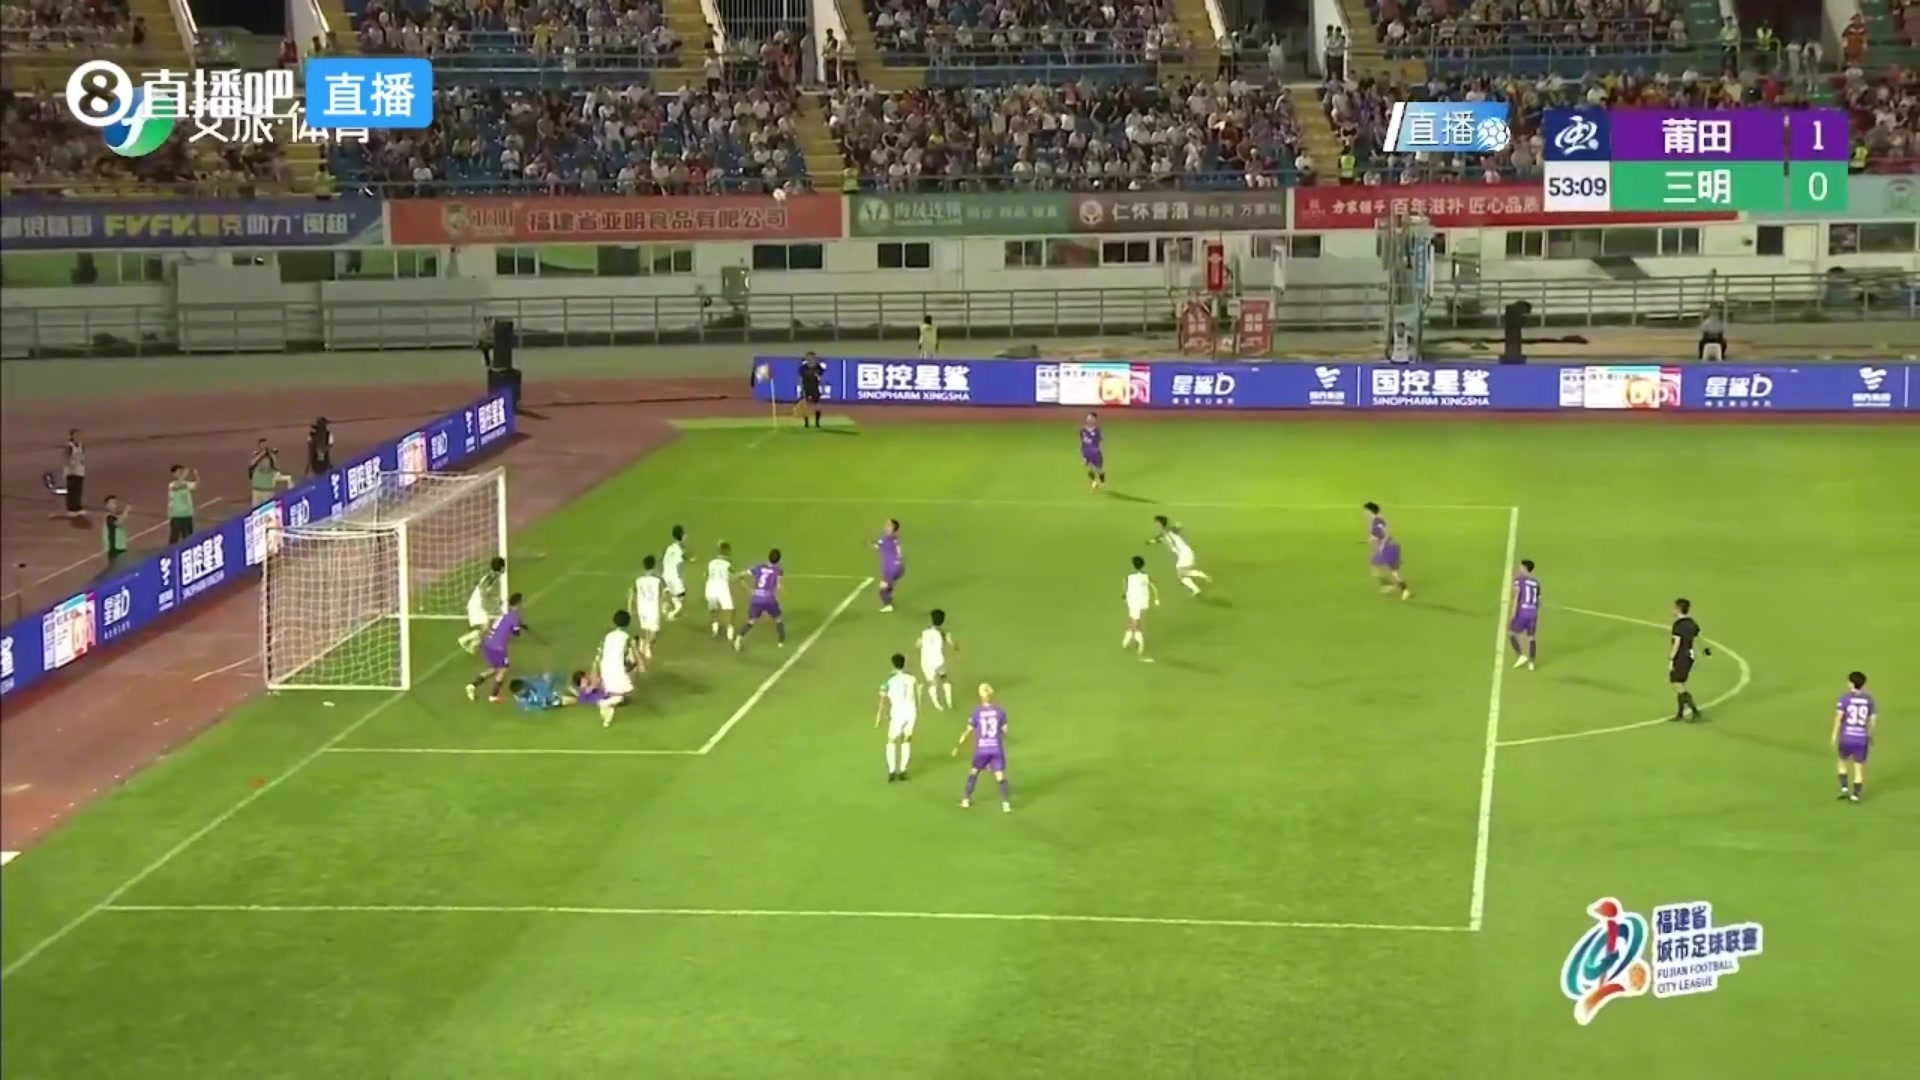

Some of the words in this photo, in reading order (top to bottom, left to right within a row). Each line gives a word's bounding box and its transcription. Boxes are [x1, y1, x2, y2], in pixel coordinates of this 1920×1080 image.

[857, 363, 971, 391] 国控星鲨
[1371, 368, 1490, 396] 国控星鲨
[857, 390, 921, 400] SINOPHARM
[922, 391, 970, 401] XINGSHA
[1846, 704, 1869, 726] 39
[980, 717, 999, 739] 13
